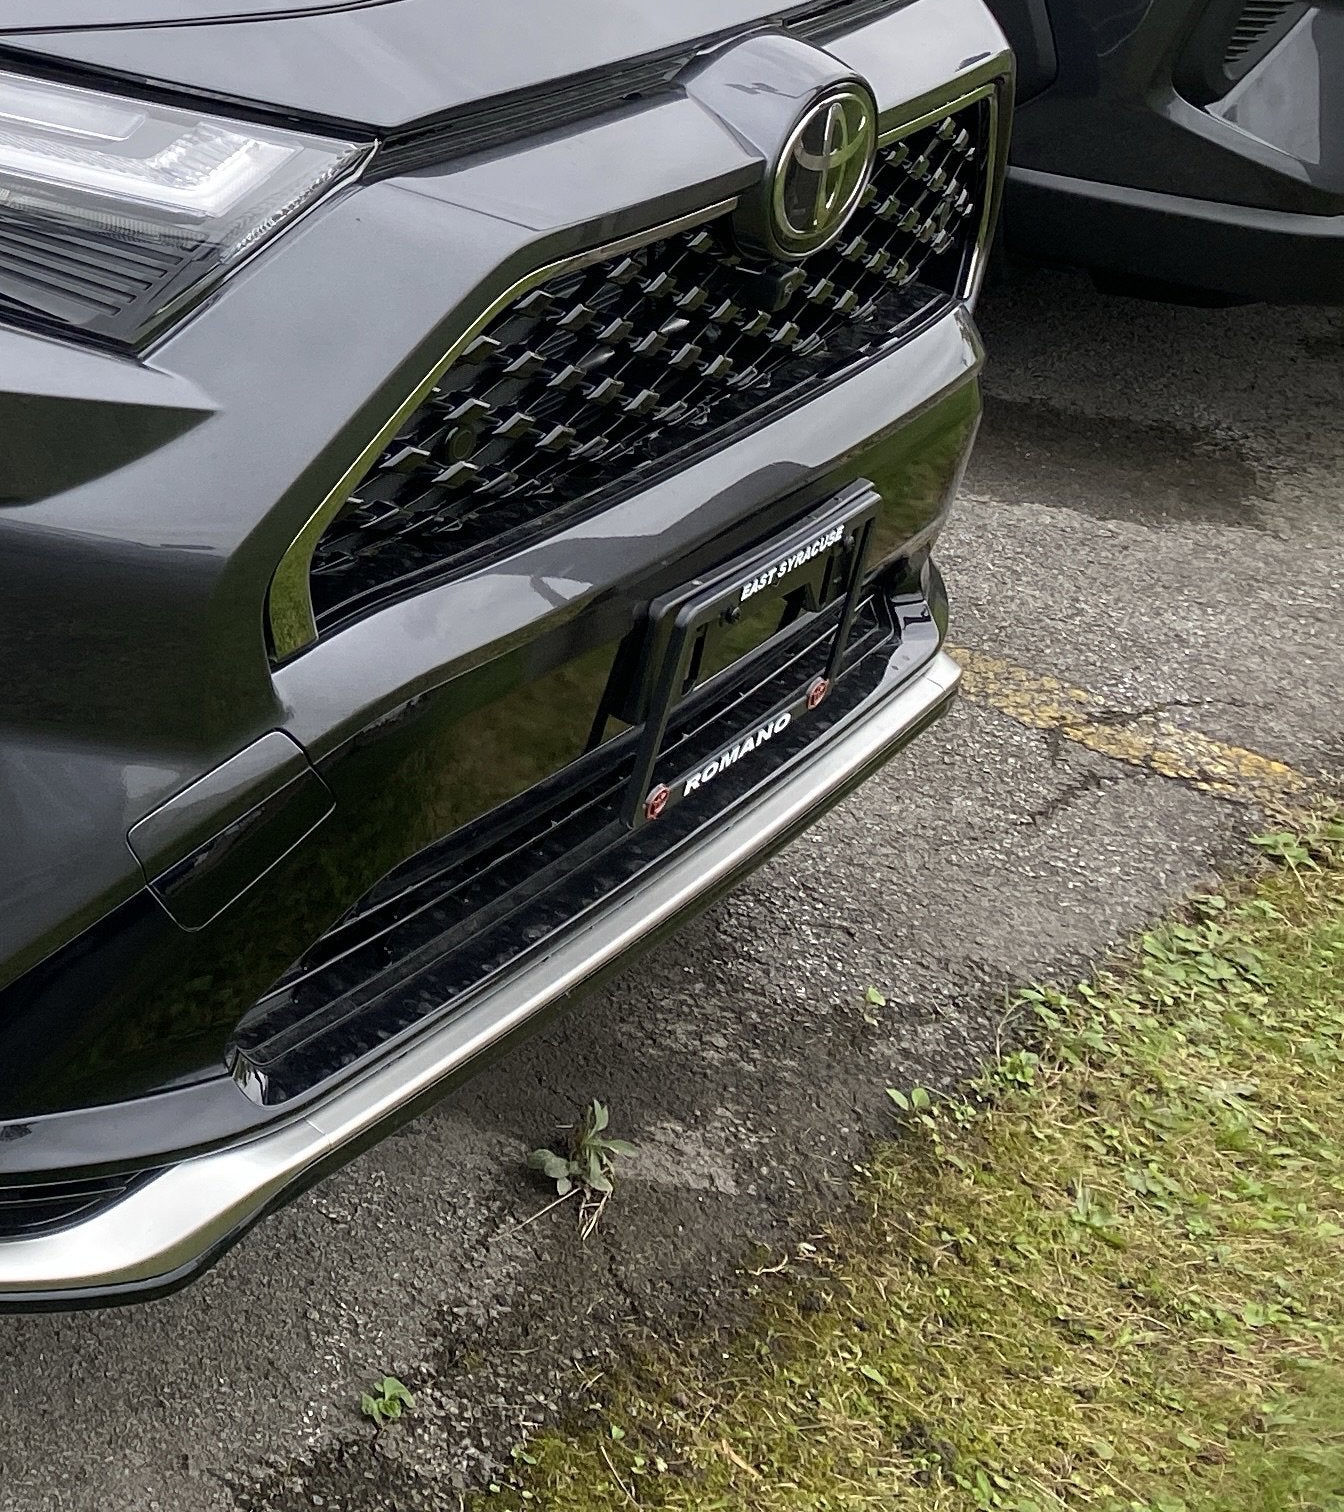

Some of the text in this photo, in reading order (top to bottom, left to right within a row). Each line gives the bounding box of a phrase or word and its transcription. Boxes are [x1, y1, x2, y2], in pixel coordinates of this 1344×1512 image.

[740, 524, 845, 602] EAST SYRACUSE
[683, 713, 792, 798] ROMANO
